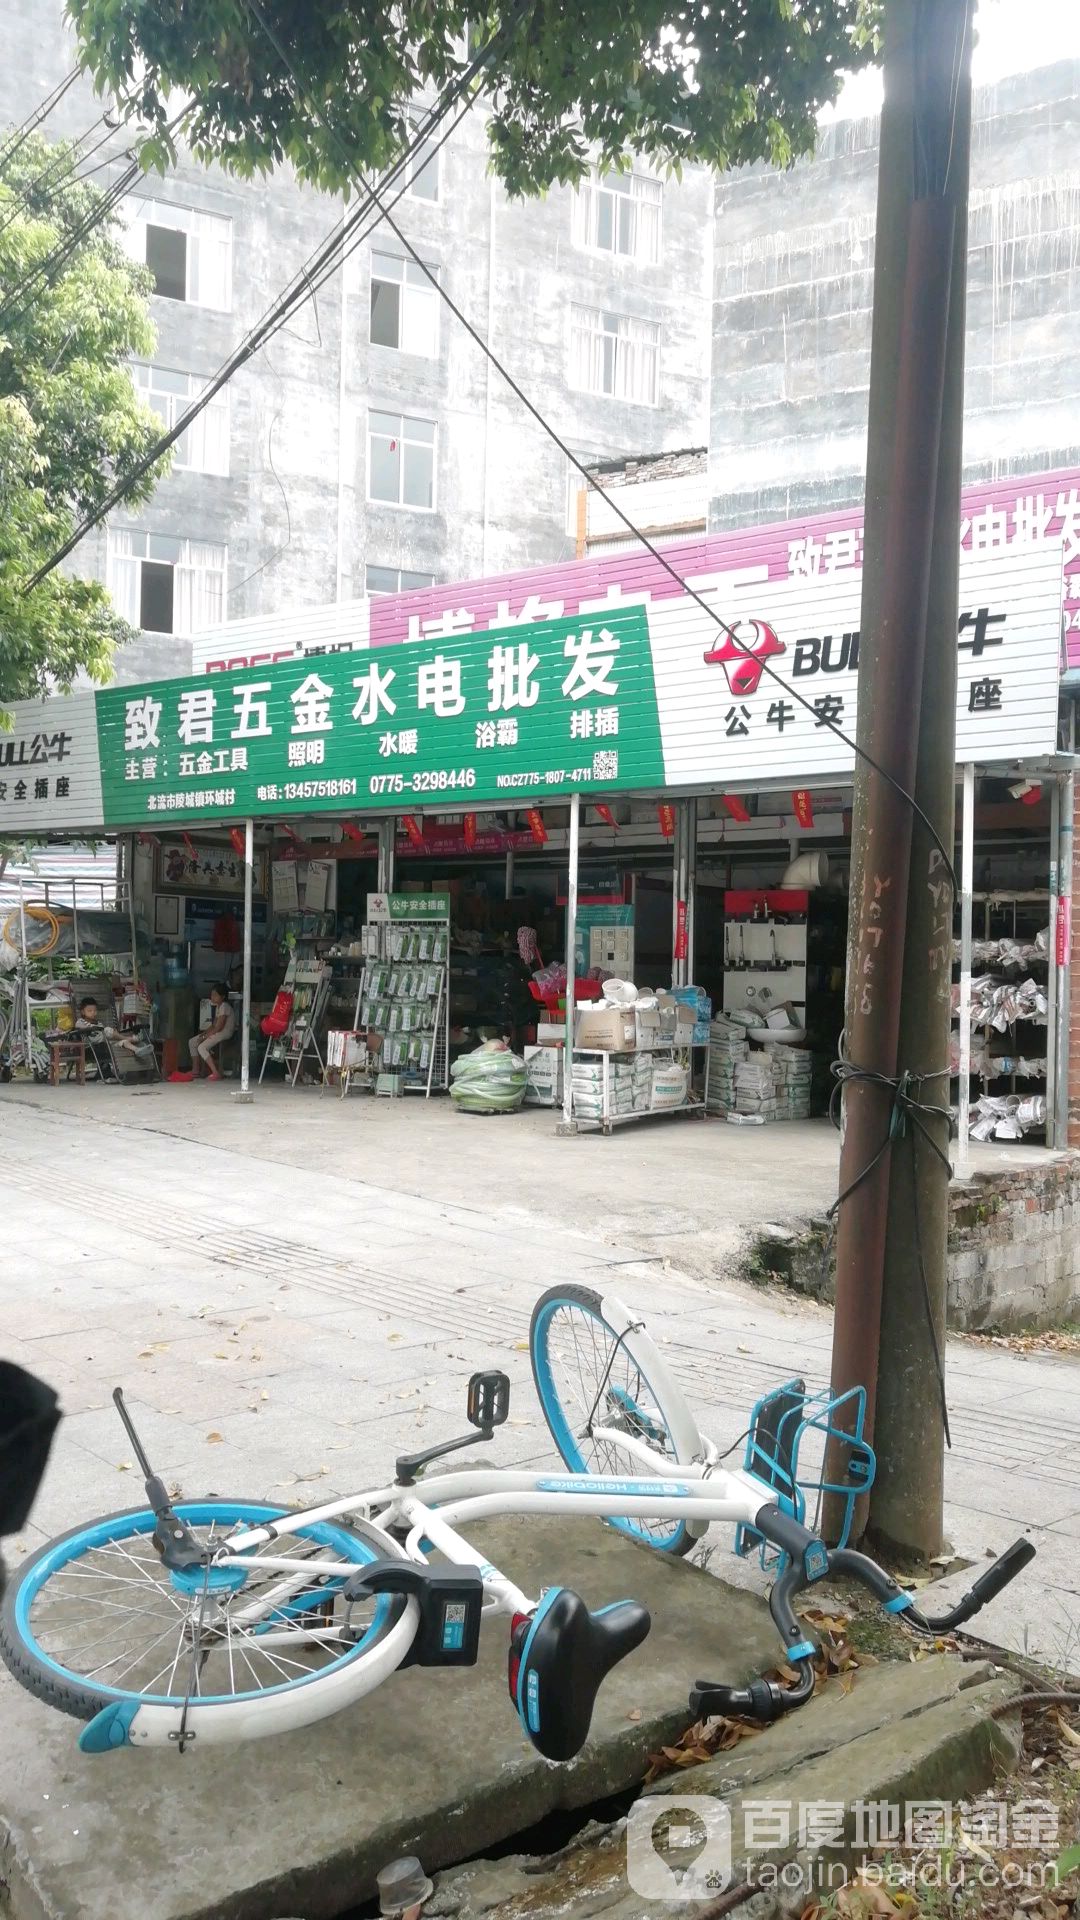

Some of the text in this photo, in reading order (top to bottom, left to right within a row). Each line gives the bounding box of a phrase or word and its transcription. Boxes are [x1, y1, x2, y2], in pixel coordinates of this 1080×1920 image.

[124, 628, 621, 751] 致君五金水电批发
[288, 739, 325, 767] 照明
[378, 729, 418, 757] 水暖
[475, 718, 518, 748] 浴霸
[570, 707, 619, 739] 排插
[370, 768, 476, 793] 0775-3298446
[392, 900, 446, 911] 公牛安全插座
